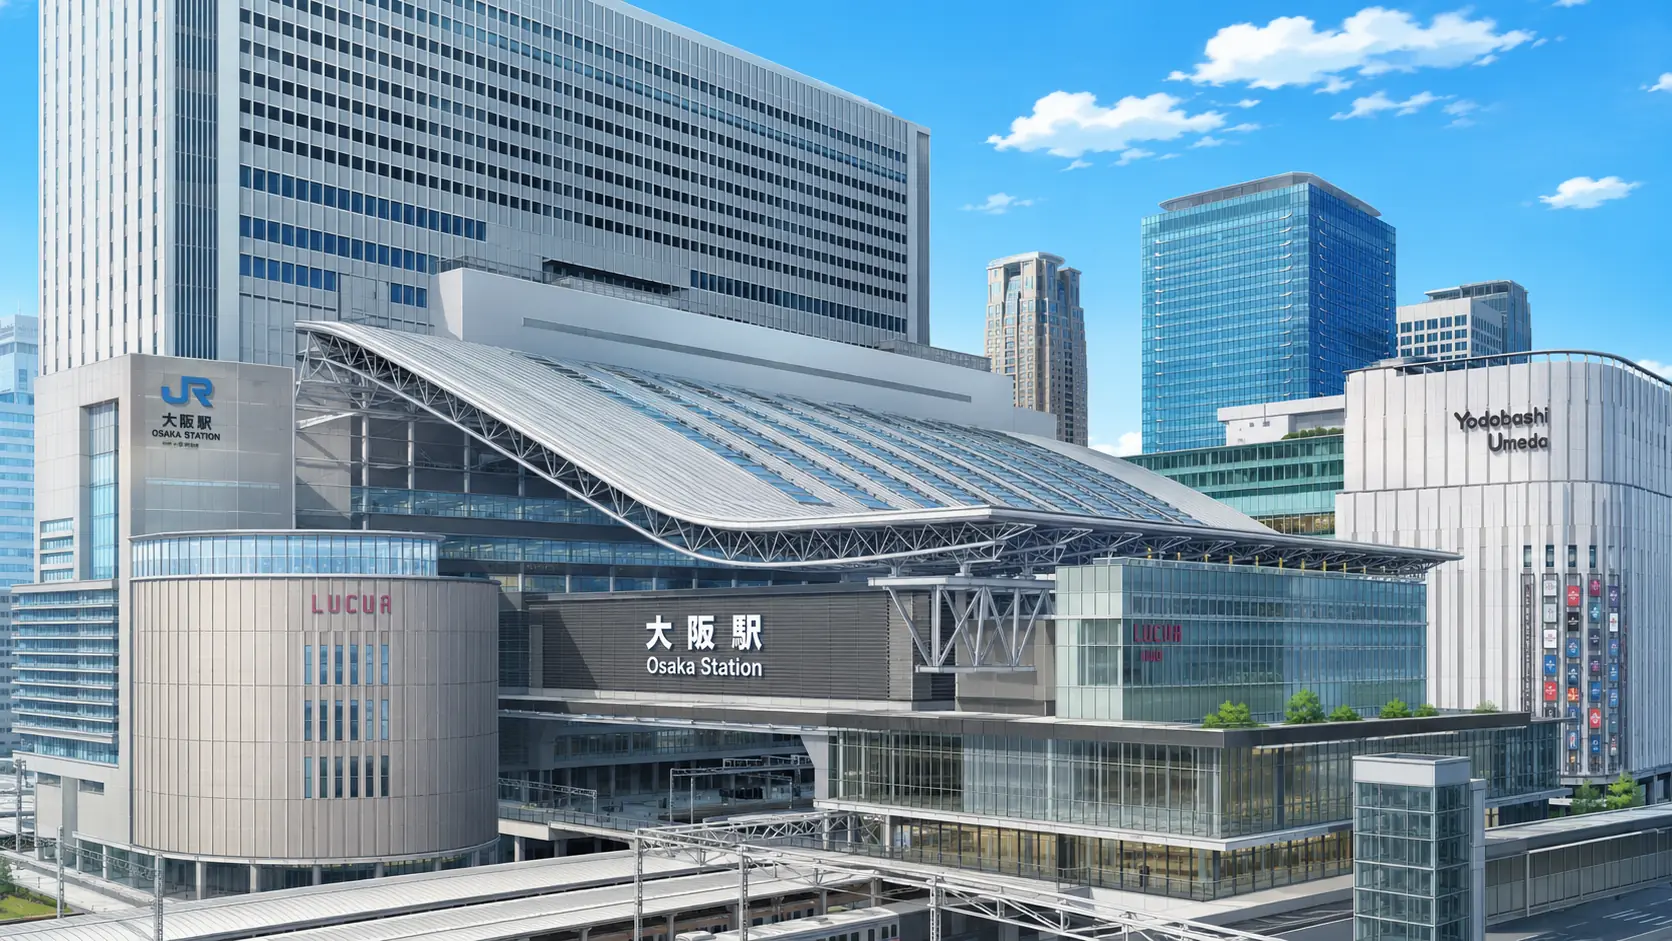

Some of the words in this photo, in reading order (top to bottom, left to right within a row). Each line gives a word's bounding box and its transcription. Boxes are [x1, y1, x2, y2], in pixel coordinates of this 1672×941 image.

[161, 376, 214, 408] JR
[162, 412, 212, 430] 大阪駅
[1454, 406, 1549, 430] Yodobashi
[152, 429, 181, 438] OSAKA
[184, 431, 220, 441] STATION
[1488, 432, 1548, 452] Umeda
[311, 594, 391, 614] LUCUA
[645, 614, 762, 650] 大阪駅
[646, 656, 695, 675] Osaka
[700, 656, 762, 676] Station
